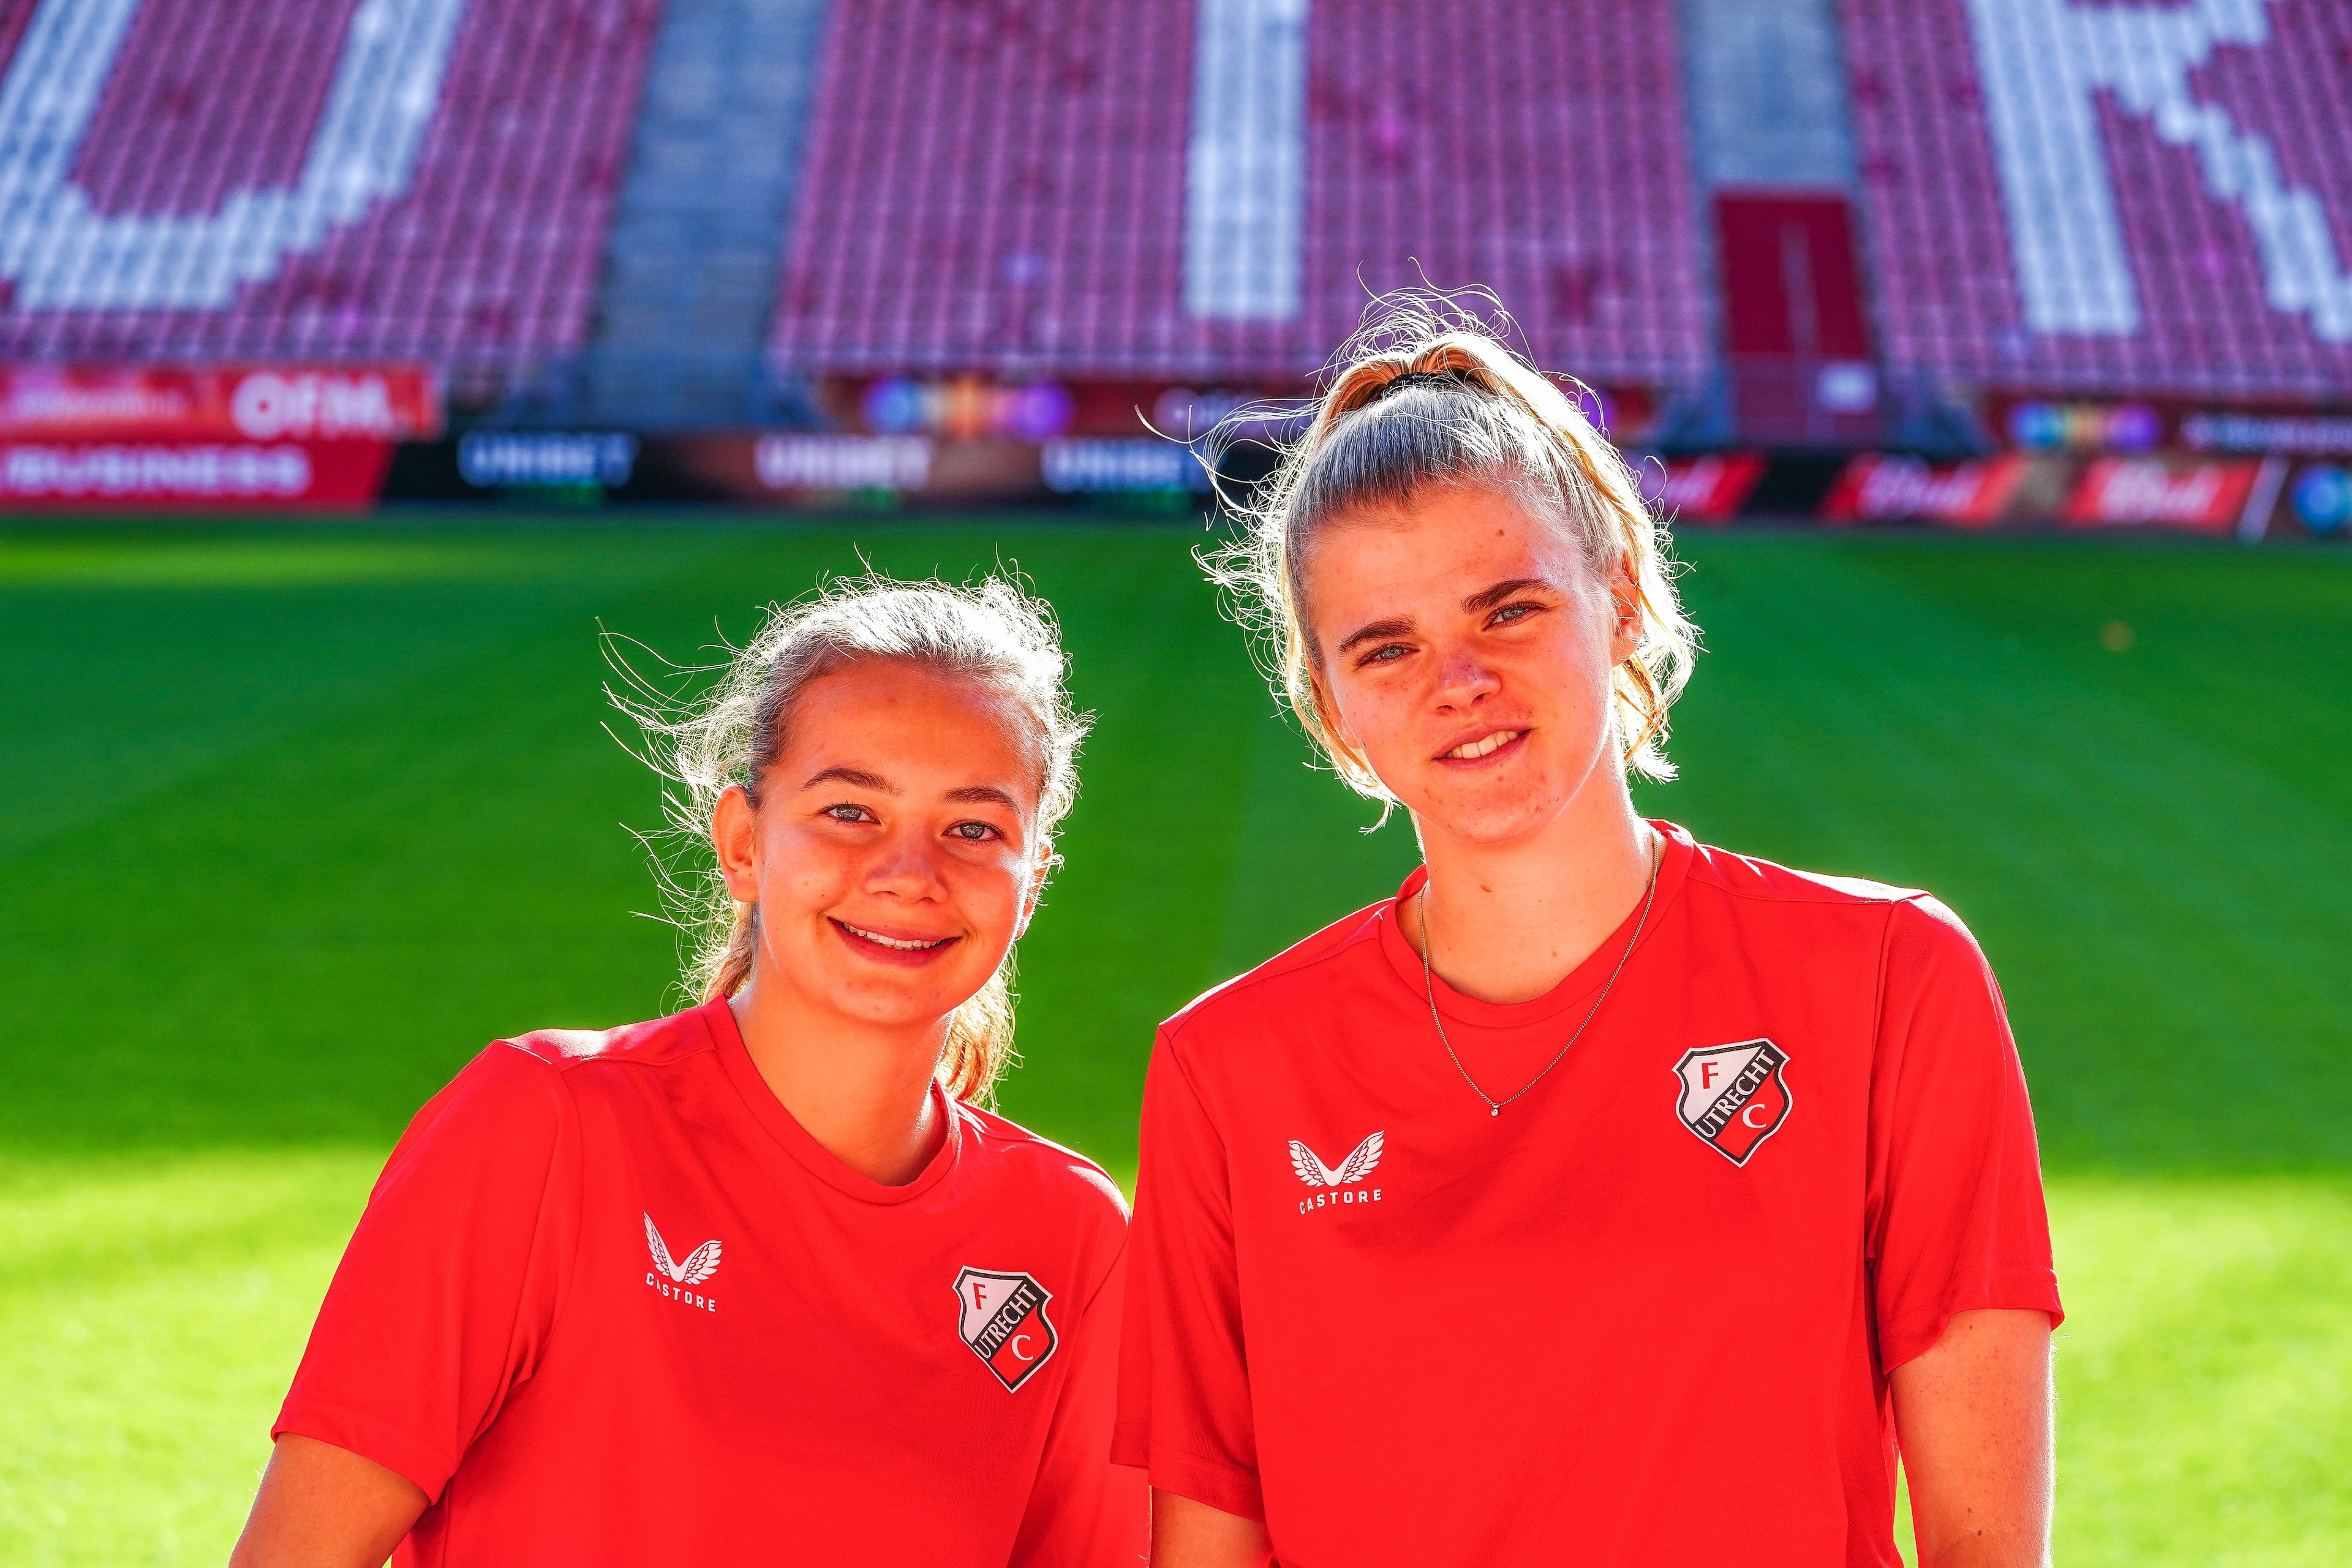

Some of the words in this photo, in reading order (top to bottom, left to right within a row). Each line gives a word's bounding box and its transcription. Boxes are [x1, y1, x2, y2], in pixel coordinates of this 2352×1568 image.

[458, 431, 638, 488] UNIBET
[755, 432, 932, 490] UNIBET
[1702, 1061, 1719, 1090] F
[1694, 1049, 1775, 1138] UTRECHT
[1741, 1104, 1767, 1129] C
[1298, 1188, 1382, 1215] CASTORE
[646, 1272, 716, 1313] CASTORE
[973, 1283, 987, 1310] F
[974, 1283, 1038, 1359] UTRECHT
[1011, 1334, 1034, 1361] C
